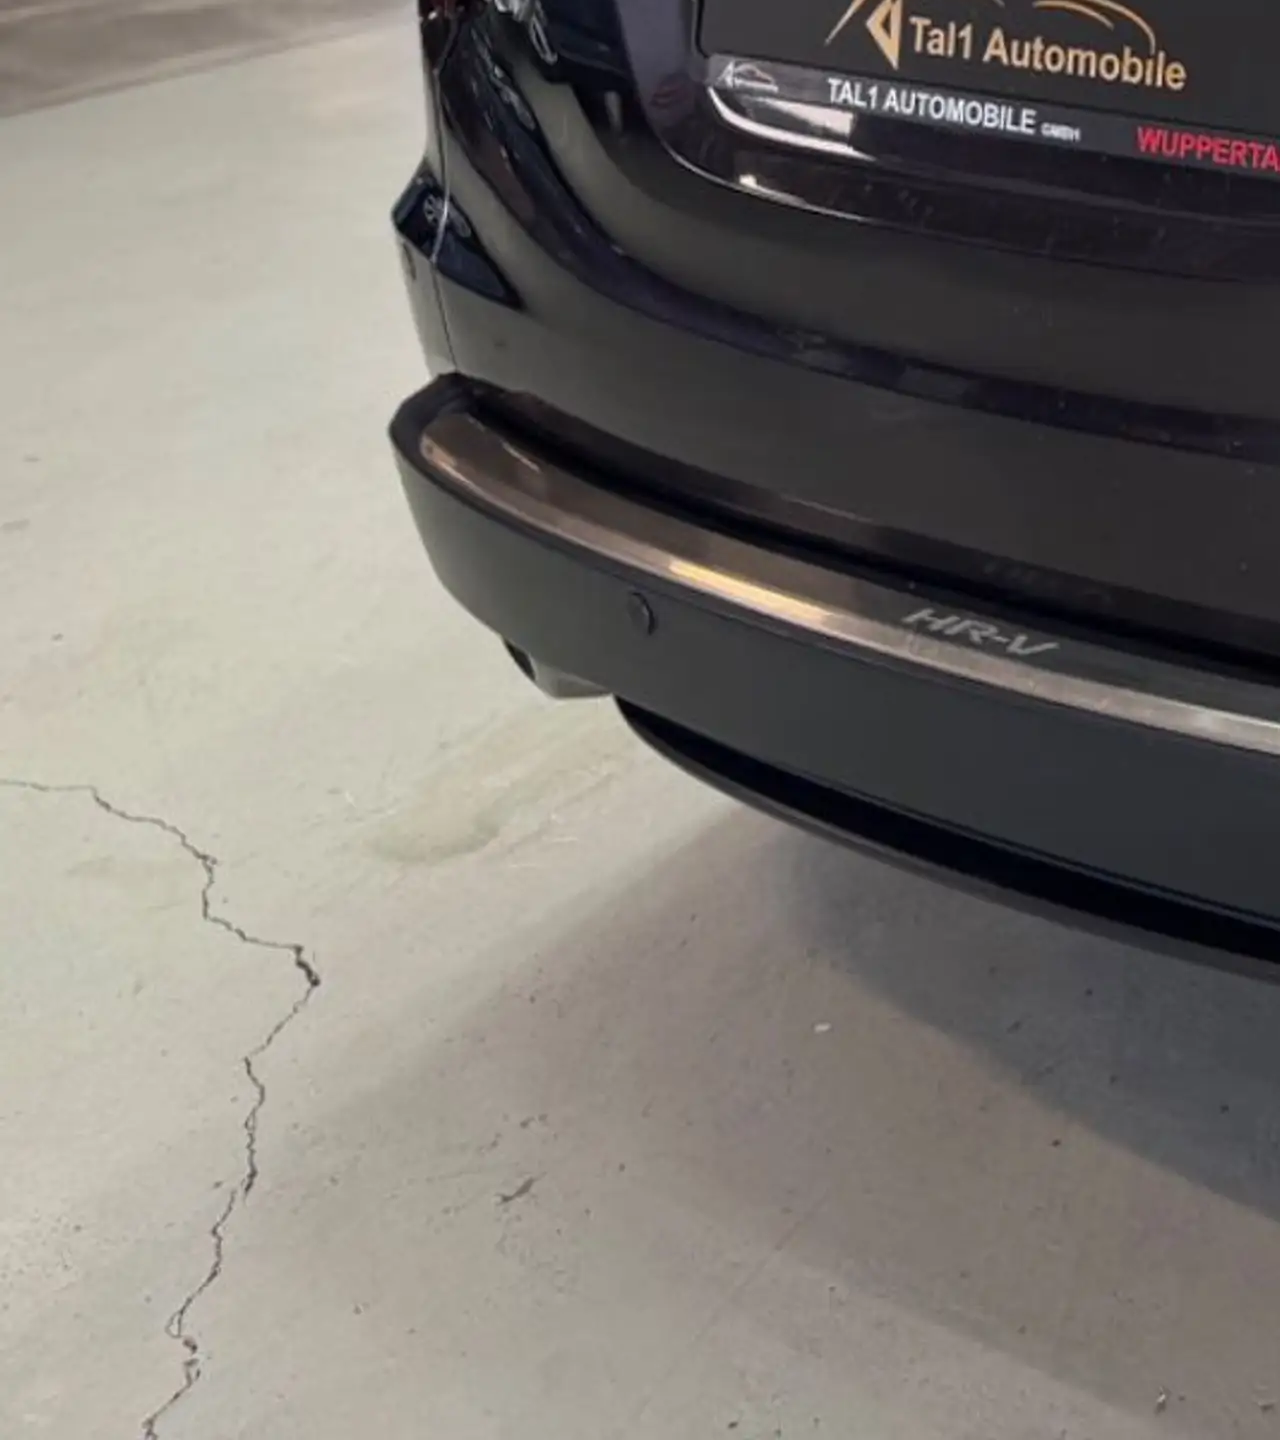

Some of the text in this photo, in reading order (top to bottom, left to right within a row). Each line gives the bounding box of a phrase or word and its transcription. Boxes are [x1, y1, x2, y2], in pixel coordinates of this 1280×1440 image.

[909, 15, 1187, 90] Tal1 Automobile
[827, 77, 878, 109] TAL1
[884, 90, 1037, 134] AUTOMOBILE
[902, 608, 1059, 654] HR-V
